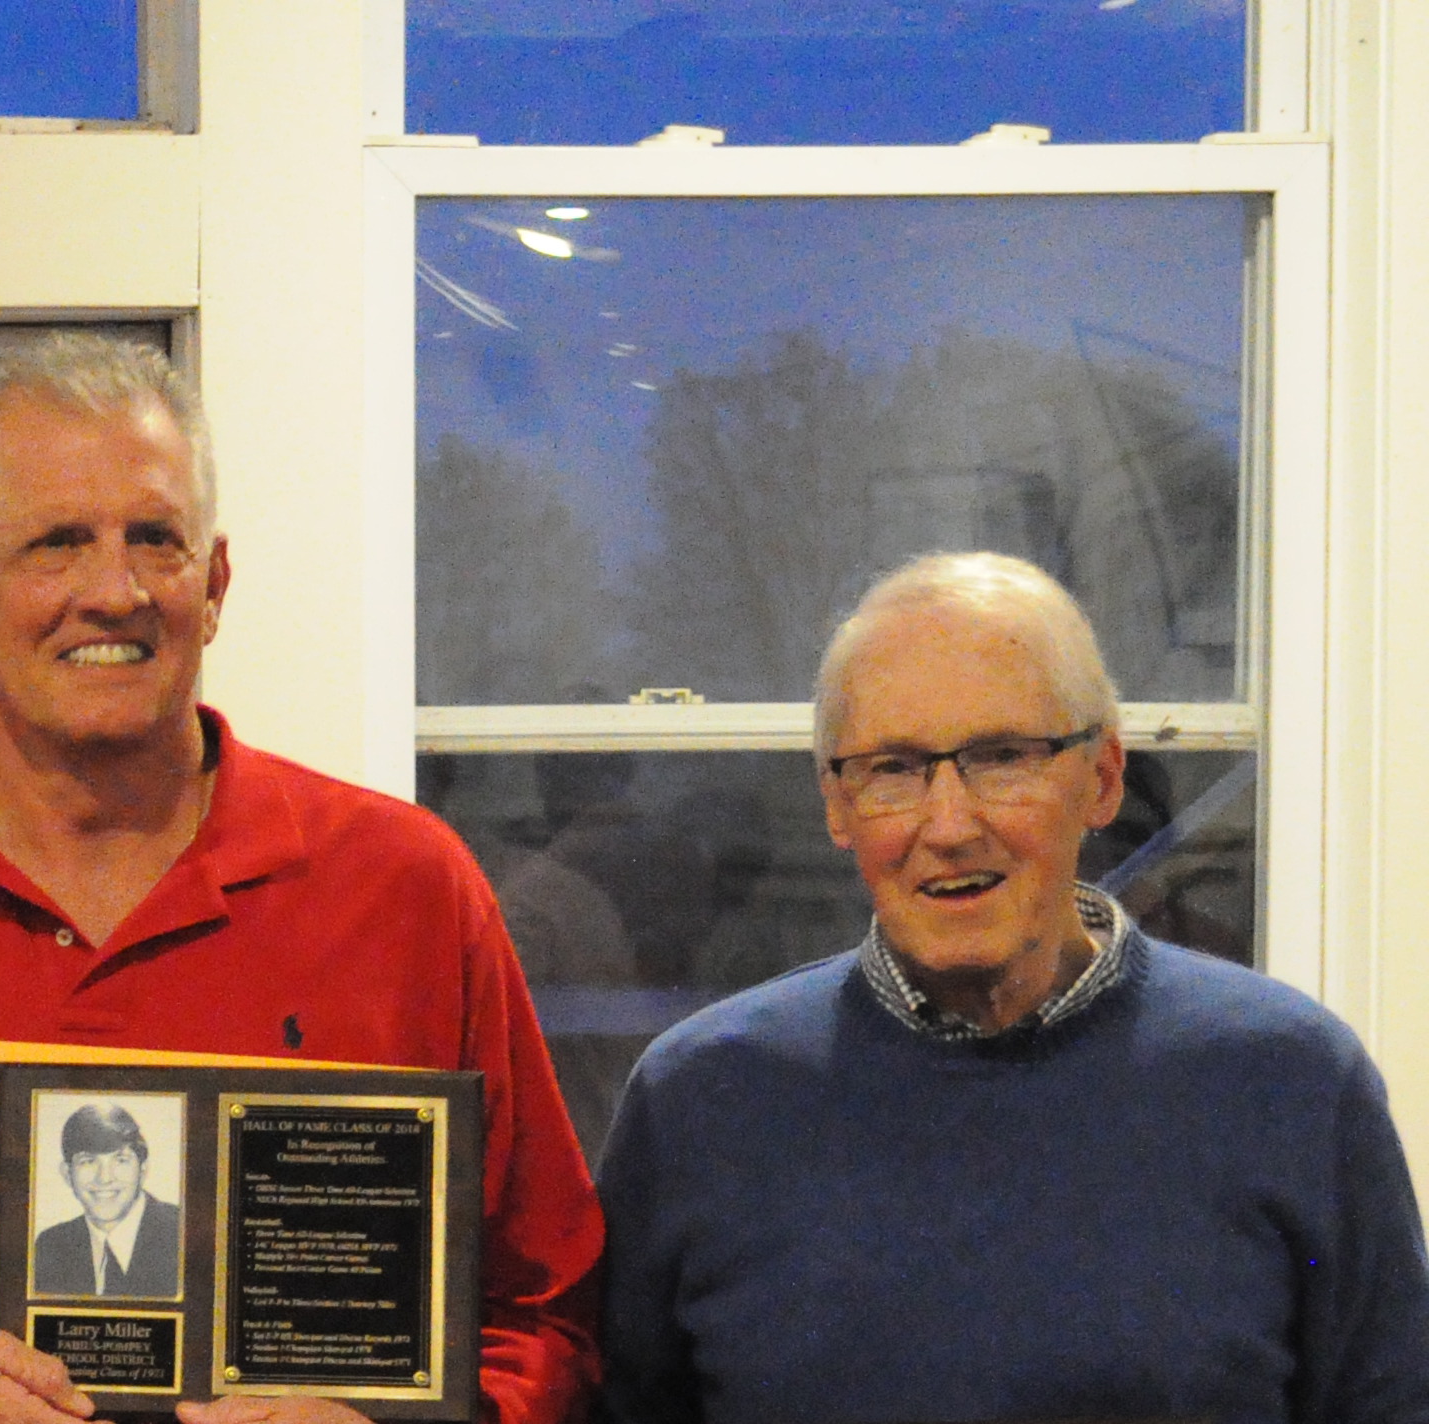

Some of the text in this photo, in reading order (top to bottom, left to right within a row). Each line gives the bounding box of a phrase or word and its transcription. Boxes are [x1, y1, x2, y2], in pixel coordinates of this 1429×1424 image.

[243, 1121, 275, 1131] HALL
[278, 1121, 294, 1132] OF
[297, 1122, 331, 1132] FAME
[333, 1122, 372, 1133] CLASS
[375, 1123, 392, 1133] OF
[57, 1321, 153, 1339] Larry Miller
